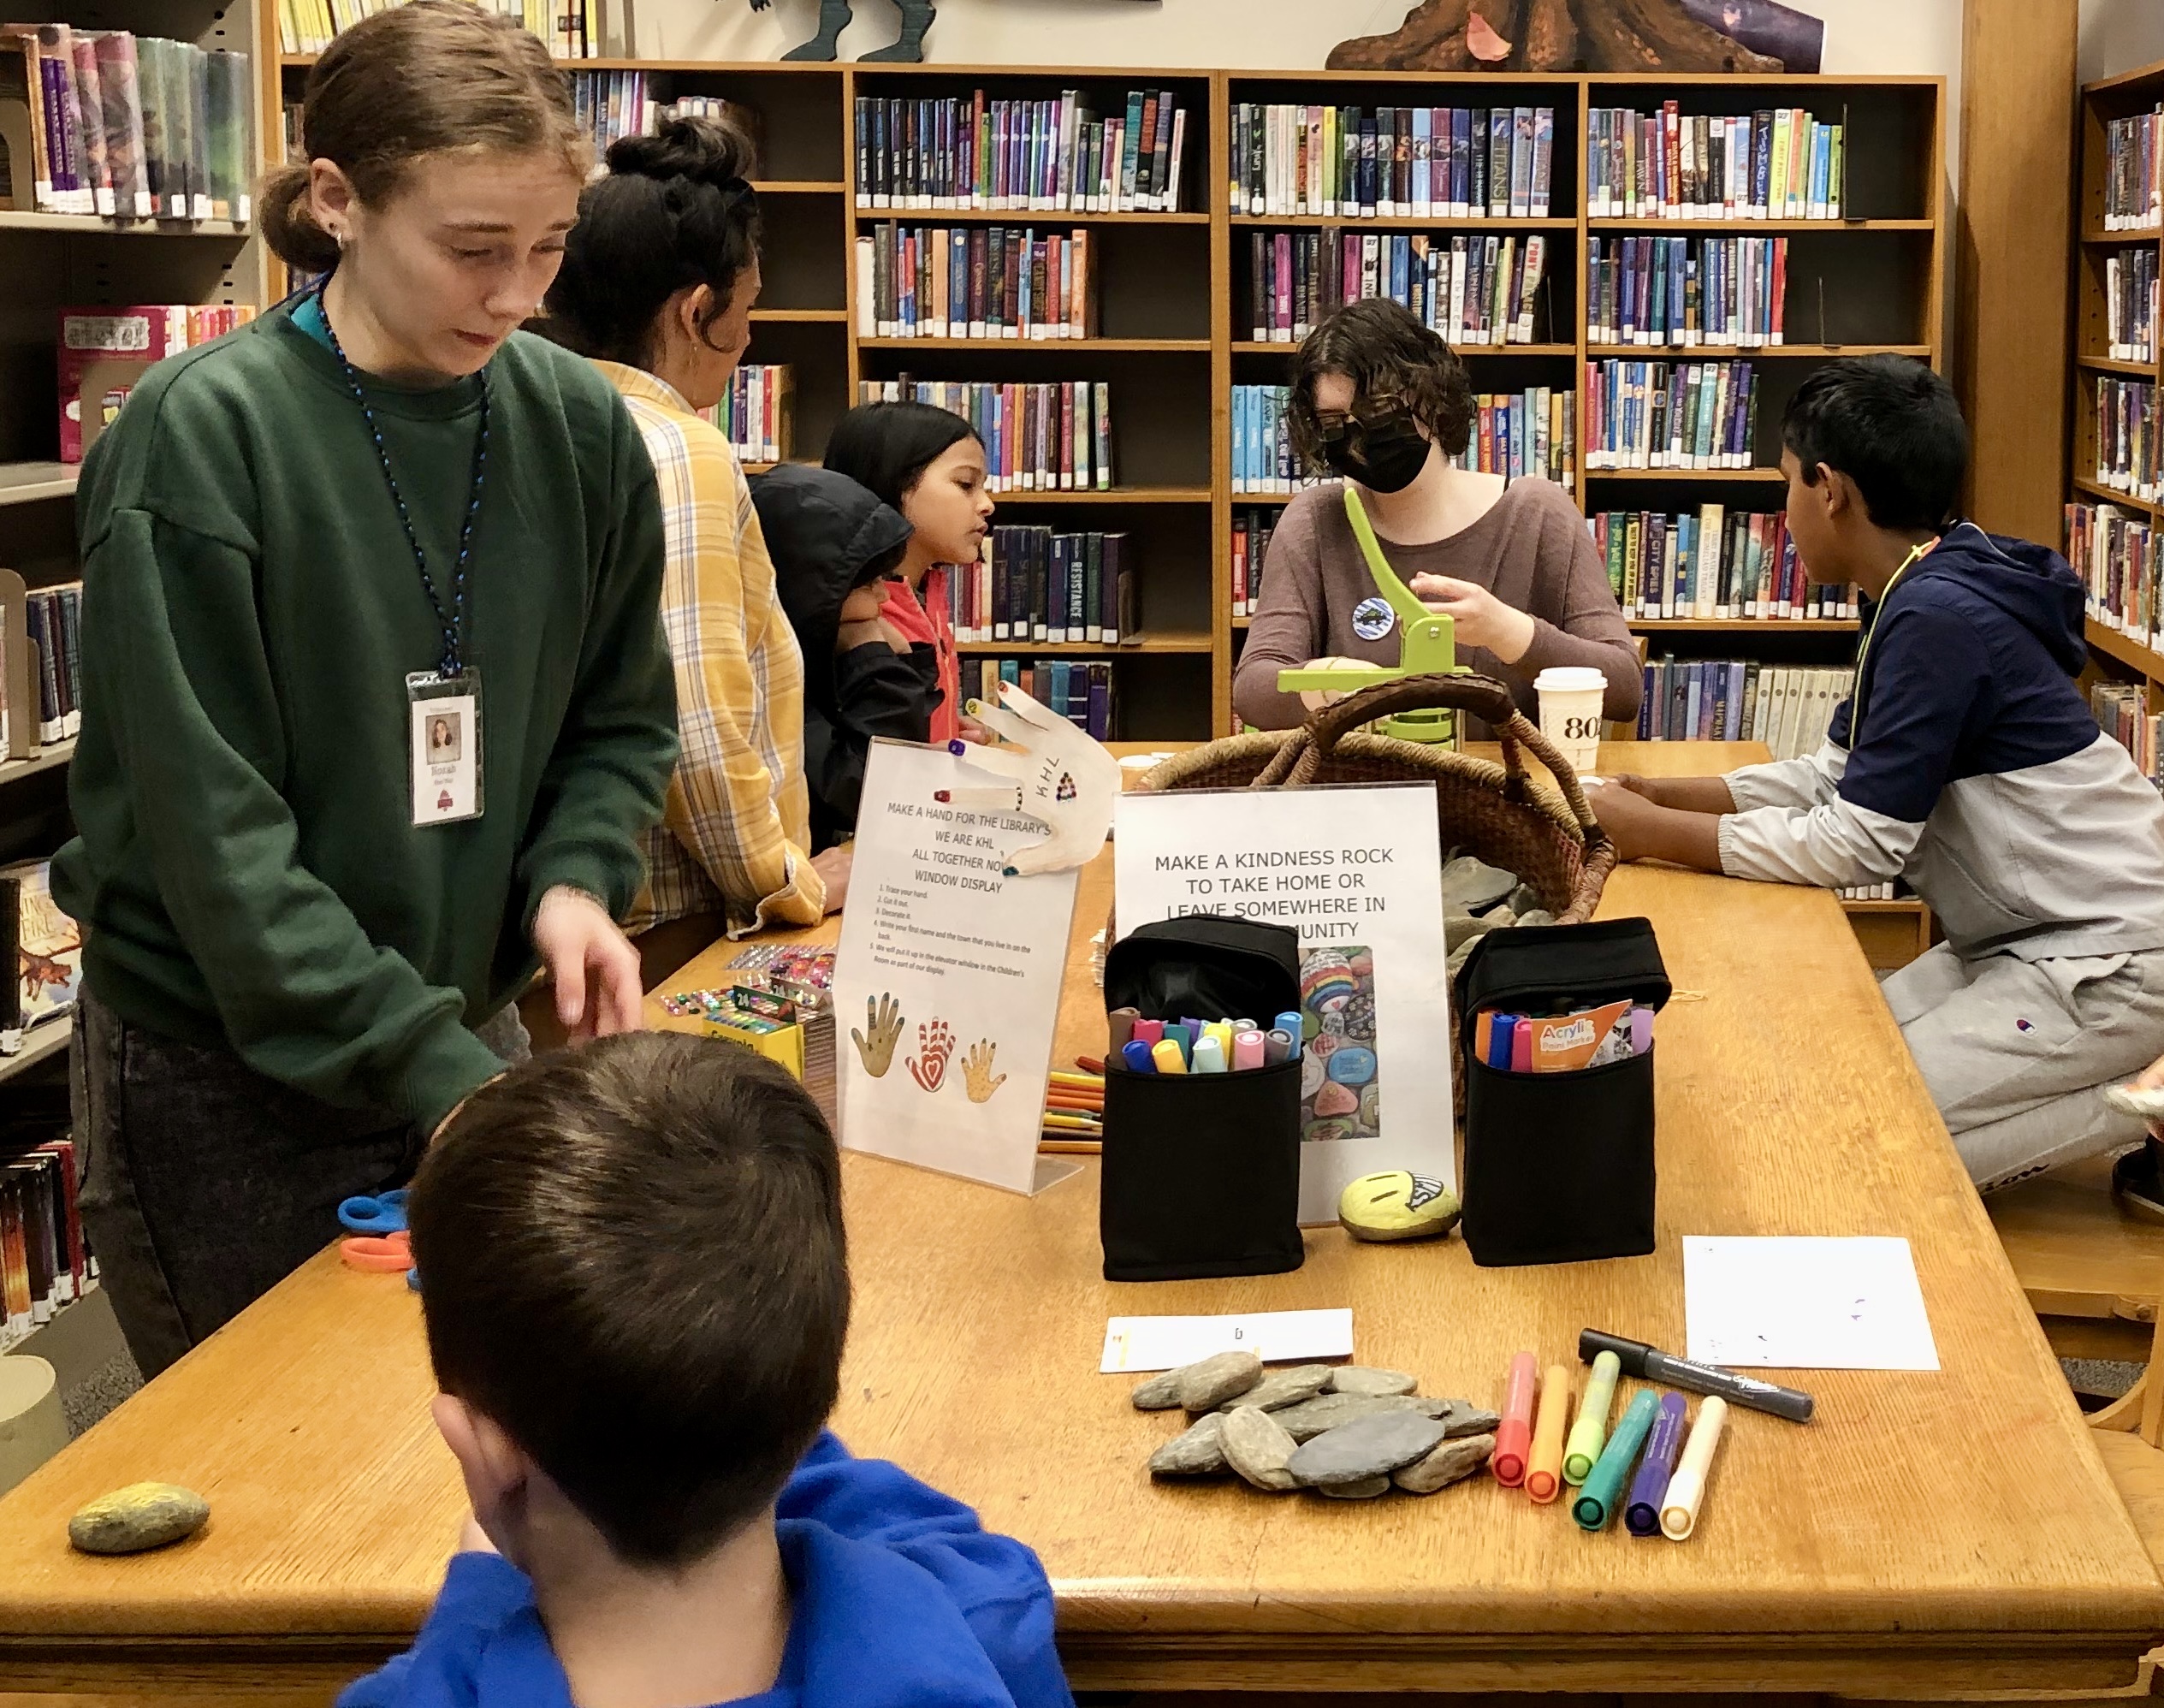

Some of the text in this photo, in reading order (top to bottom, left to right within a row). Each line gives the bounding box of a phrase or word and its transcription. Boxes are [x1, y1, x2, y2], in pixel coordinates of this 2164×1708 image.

[1493, 142, 1508, 199] TITANS
[1527, 242, 1540, 271] PONY
[1649, 540, 1661, 594] CITY SPIES
[1070, 561, 1082, 618] RESISTANCE
[1035, 757, 1060, 798] KHL
[887, 803, 1052, 836] MAKE A HAND FOR THE LIBRARY'S
[935, 831, 994, 850] WE ARE KHL
[912, 849, 928, 861] ALL
[932, 851, 983, 869] TOGETHER
[1155, 848, 1394, 872] MAKE A KINDNESS ROCK
[886, 885, 899, 894] Trace
[900, 887, 913, 897] your
[914, 889, 928, 898] hand.
[915, 869, 1002, 893] WINDOW DISPLAY
[1186, 873, 1366, 895] TO TAKE HOME OR
[881, 908, 905, 919] Decorate
[1167, 897, 1385, 920] LEAVE SOMEWHERE IN
[908, 924, 919, 934] first
[920, 928, 934, 937] name
[935, 929, 946, 939] and
[946, 932, 957, 940] the
[972, 936, 983, 946] that
[984, 939, 994, 948] you
[995, 940, 1005, 949] live
[1295, 922, 1359, 940] UNITY
[874, 955, 889, 964] Room
[897, 960, 909, 970] part
[895, 948, 905, 957] put
[925, 952, 934, 961] the
[987, 964, 996, 973] the
[997, 965, 1025, 978] Children's
[736, 993, 750, 1007] 24
[773, 985, 786, 997] 24
[711, 1029, 754, 1051] Caola
[1543, 1019, 1594, 1039] Acrylic
